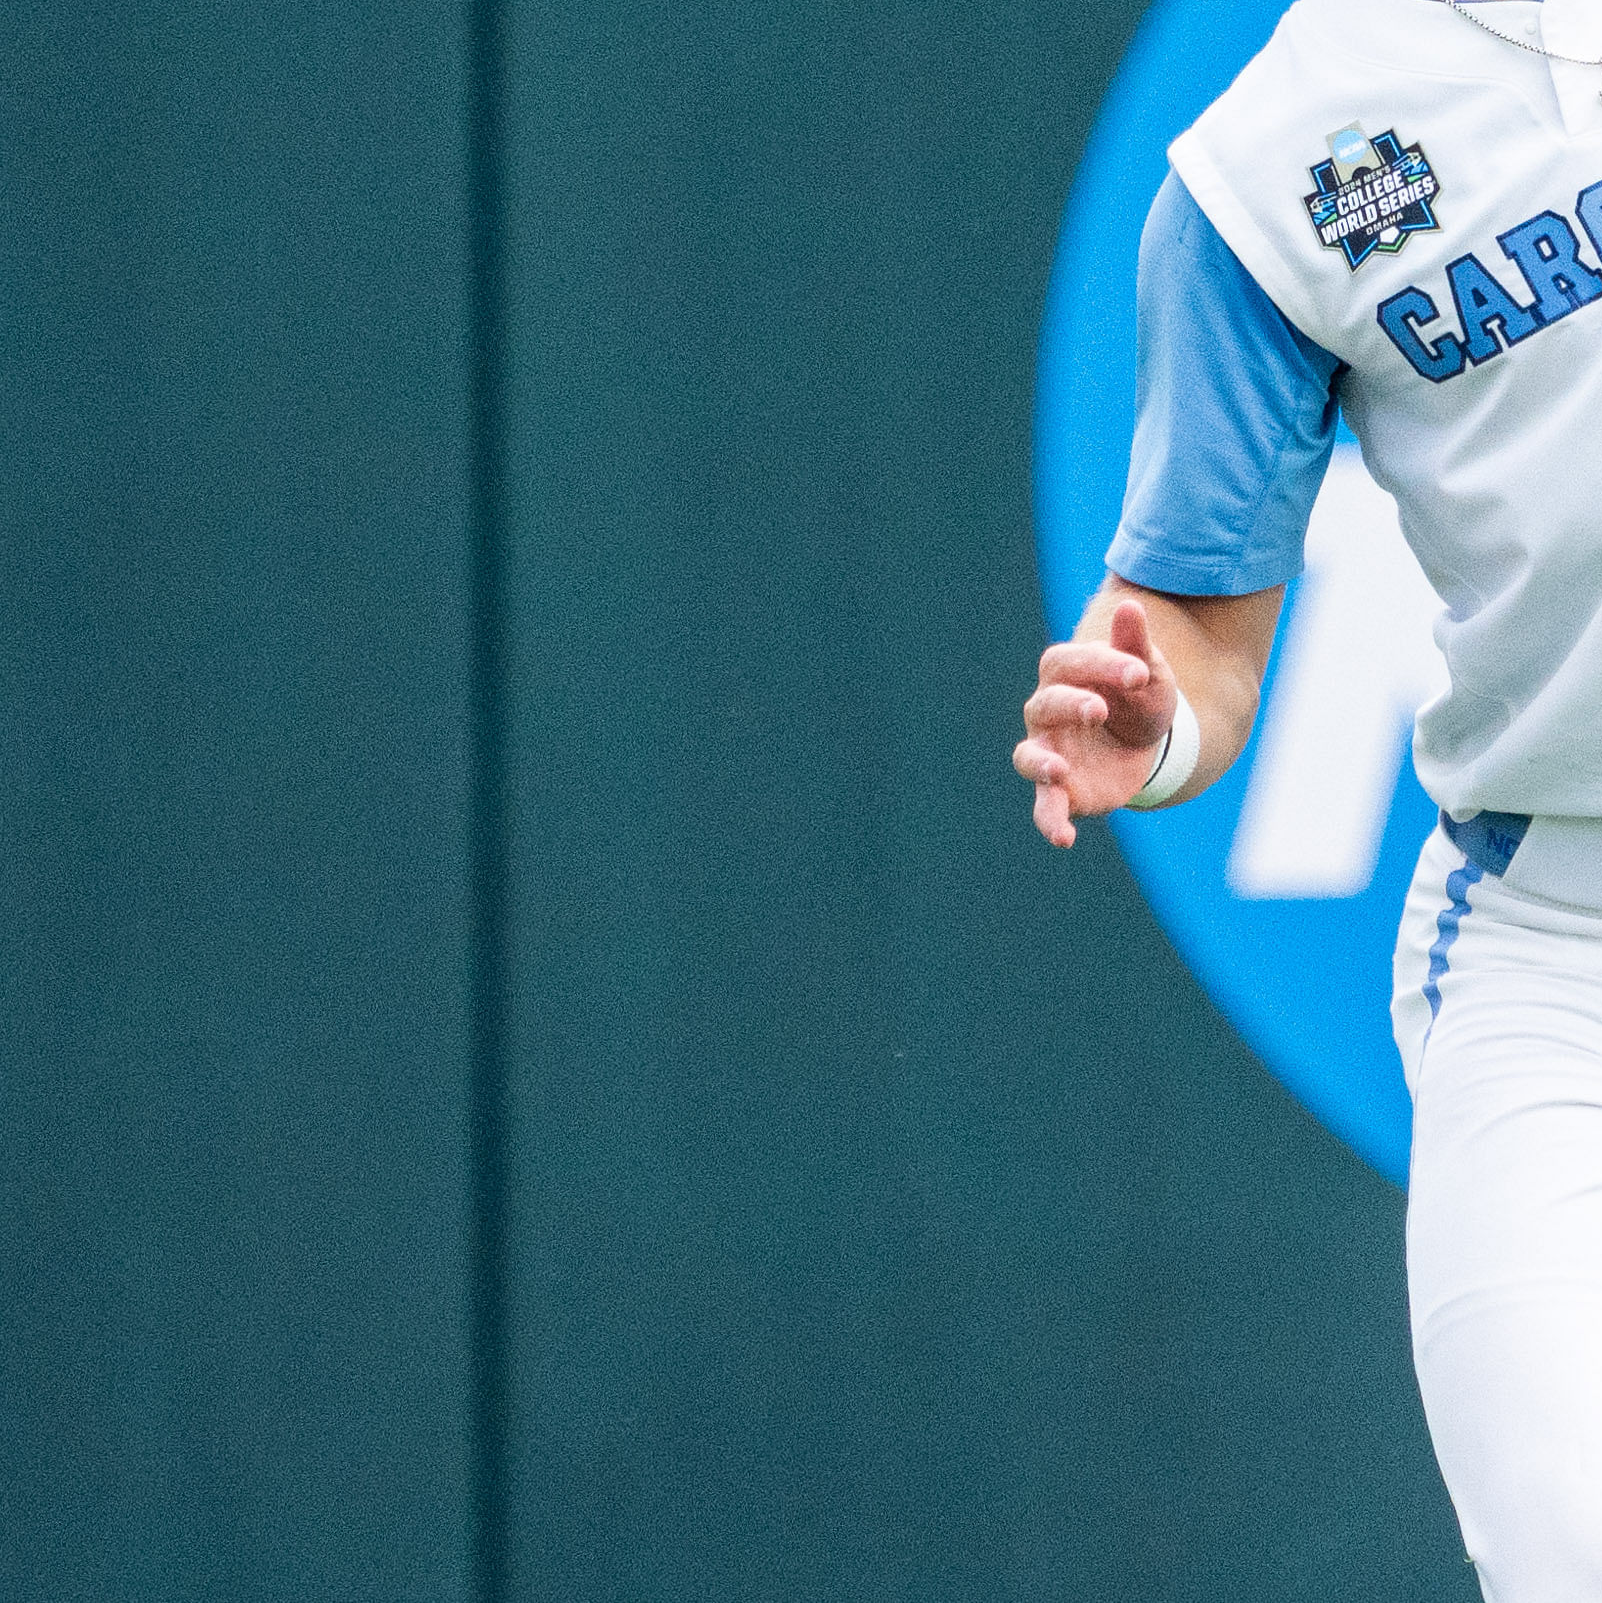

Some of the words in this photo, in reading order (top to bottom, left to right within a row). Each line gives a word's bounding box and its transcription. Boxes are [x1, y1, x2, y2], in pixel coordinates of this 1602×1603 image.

[1336, 169, 1404, 216] COLLEGE
[1338, 179, 1362, 196] 2024
[1363, 165, 1391, 184] MEN'S
[1320, 203, 1377, 245] WORLD
[1378, 176, 1435, 217] SERIES
[1366, 212, 1404, 235] OMAHA
